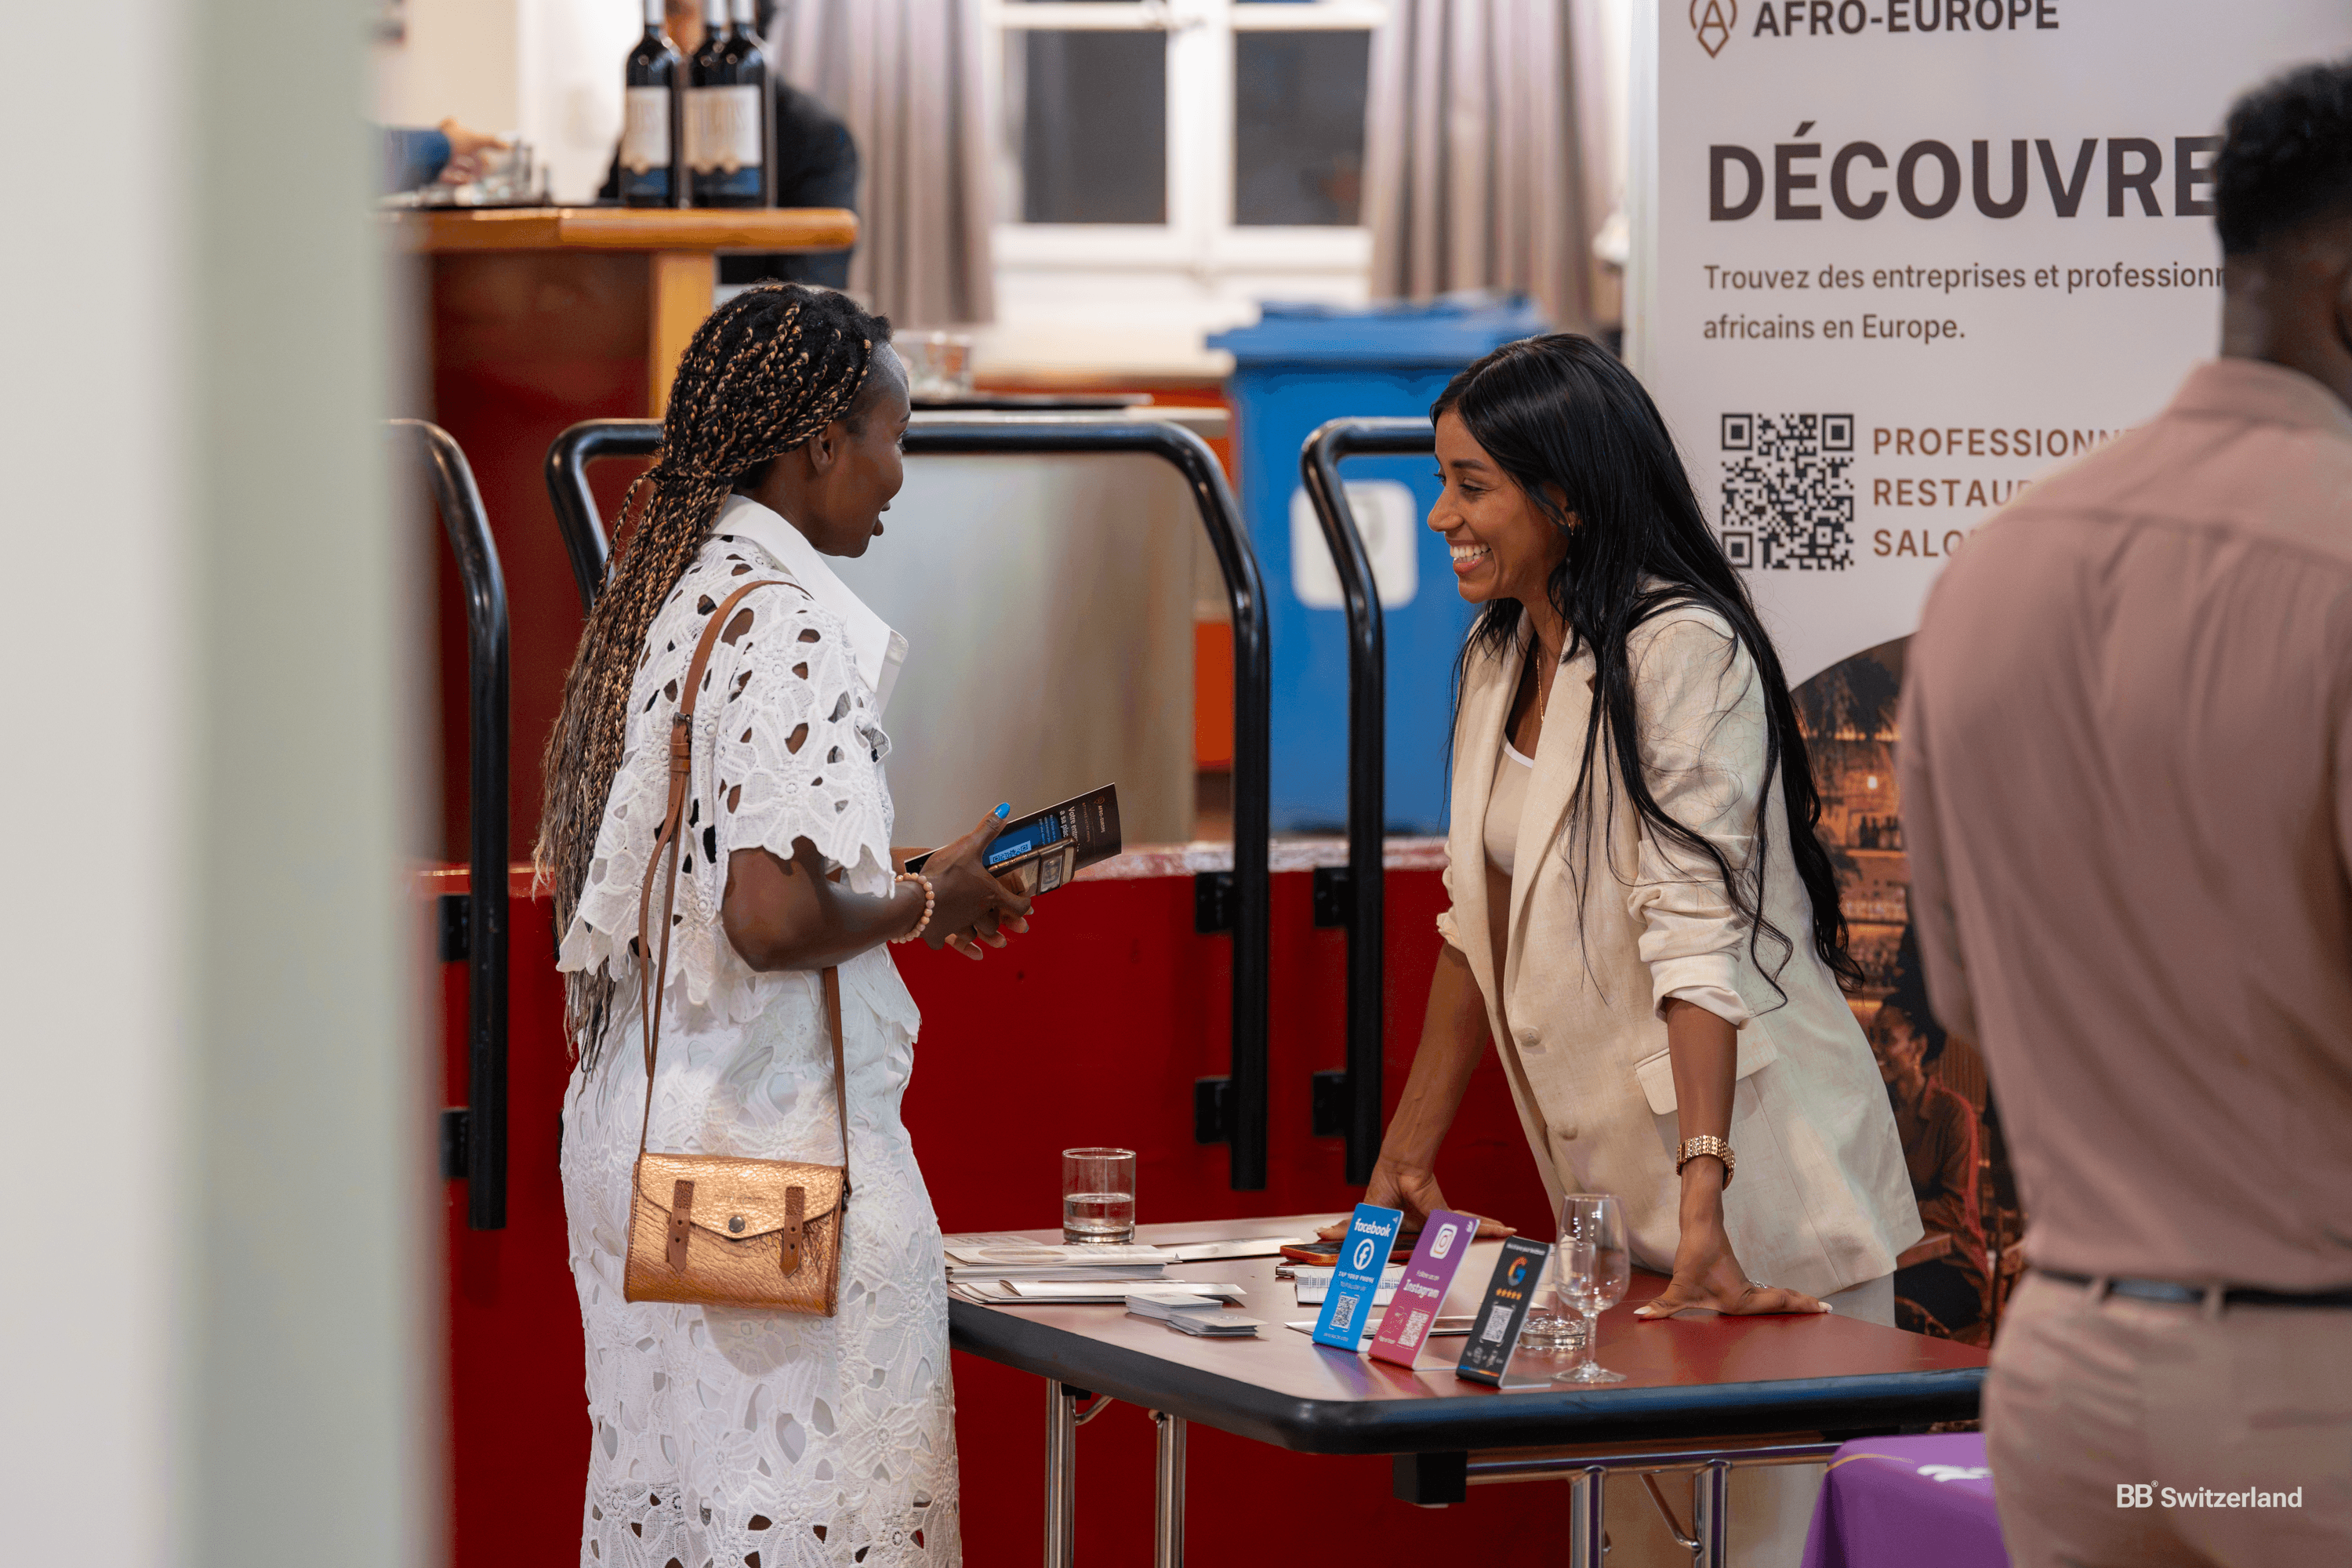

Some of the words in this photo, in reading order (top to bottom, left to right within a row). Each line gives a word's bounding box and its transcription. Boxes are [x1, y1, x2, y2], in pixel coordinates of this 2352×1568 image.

[1753, 0, 2060, 37] AFRO-EUROPE
[1704, 264, 1810, 289] Trouvez
[1817, 263, 1866, 289] des
[1872, 262, 2027, 294] entreprises
[2034, 264, 2060, 288] et
[1703, 314, 1816, 339] africains
[1823, 319, 1854, 339] en
[1862, 314, 1965, 345] Europe.
[1060, 815, 1066, 825] sa
[1068, 806, 1076, 825] Votre
[1354, 1217, 1392, 1237] facebook
[1403, 1278, 1440, 1298] Instagram
